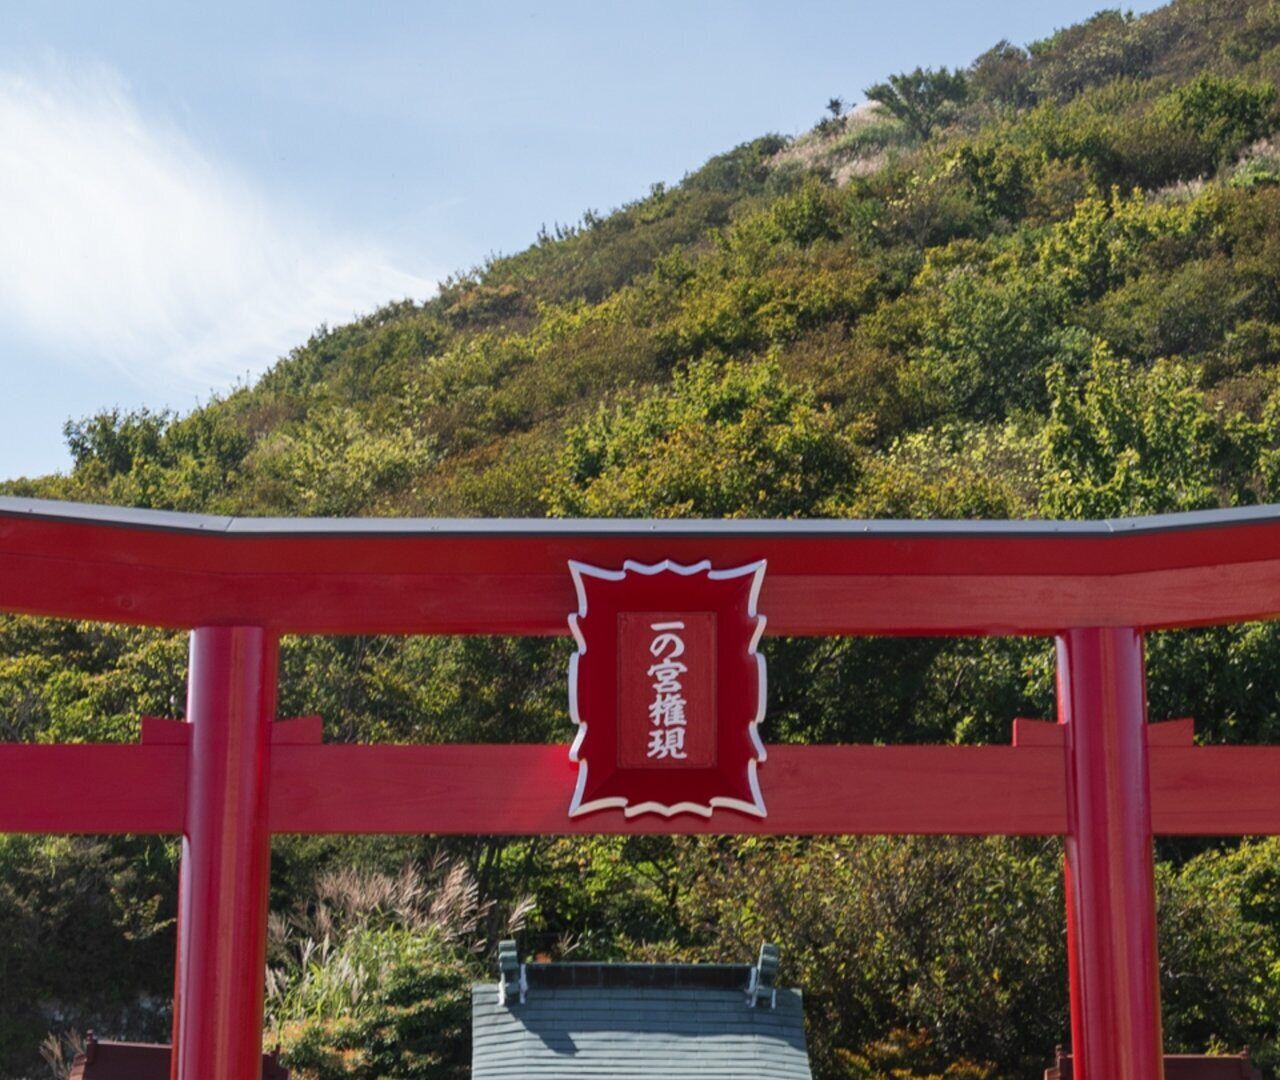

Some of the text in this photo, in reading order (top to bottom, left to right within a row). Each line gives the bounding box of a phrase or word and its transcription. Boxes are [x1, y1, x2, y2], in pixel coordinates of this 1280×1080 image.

[647, 621, 688, 759] 一の宮権現
